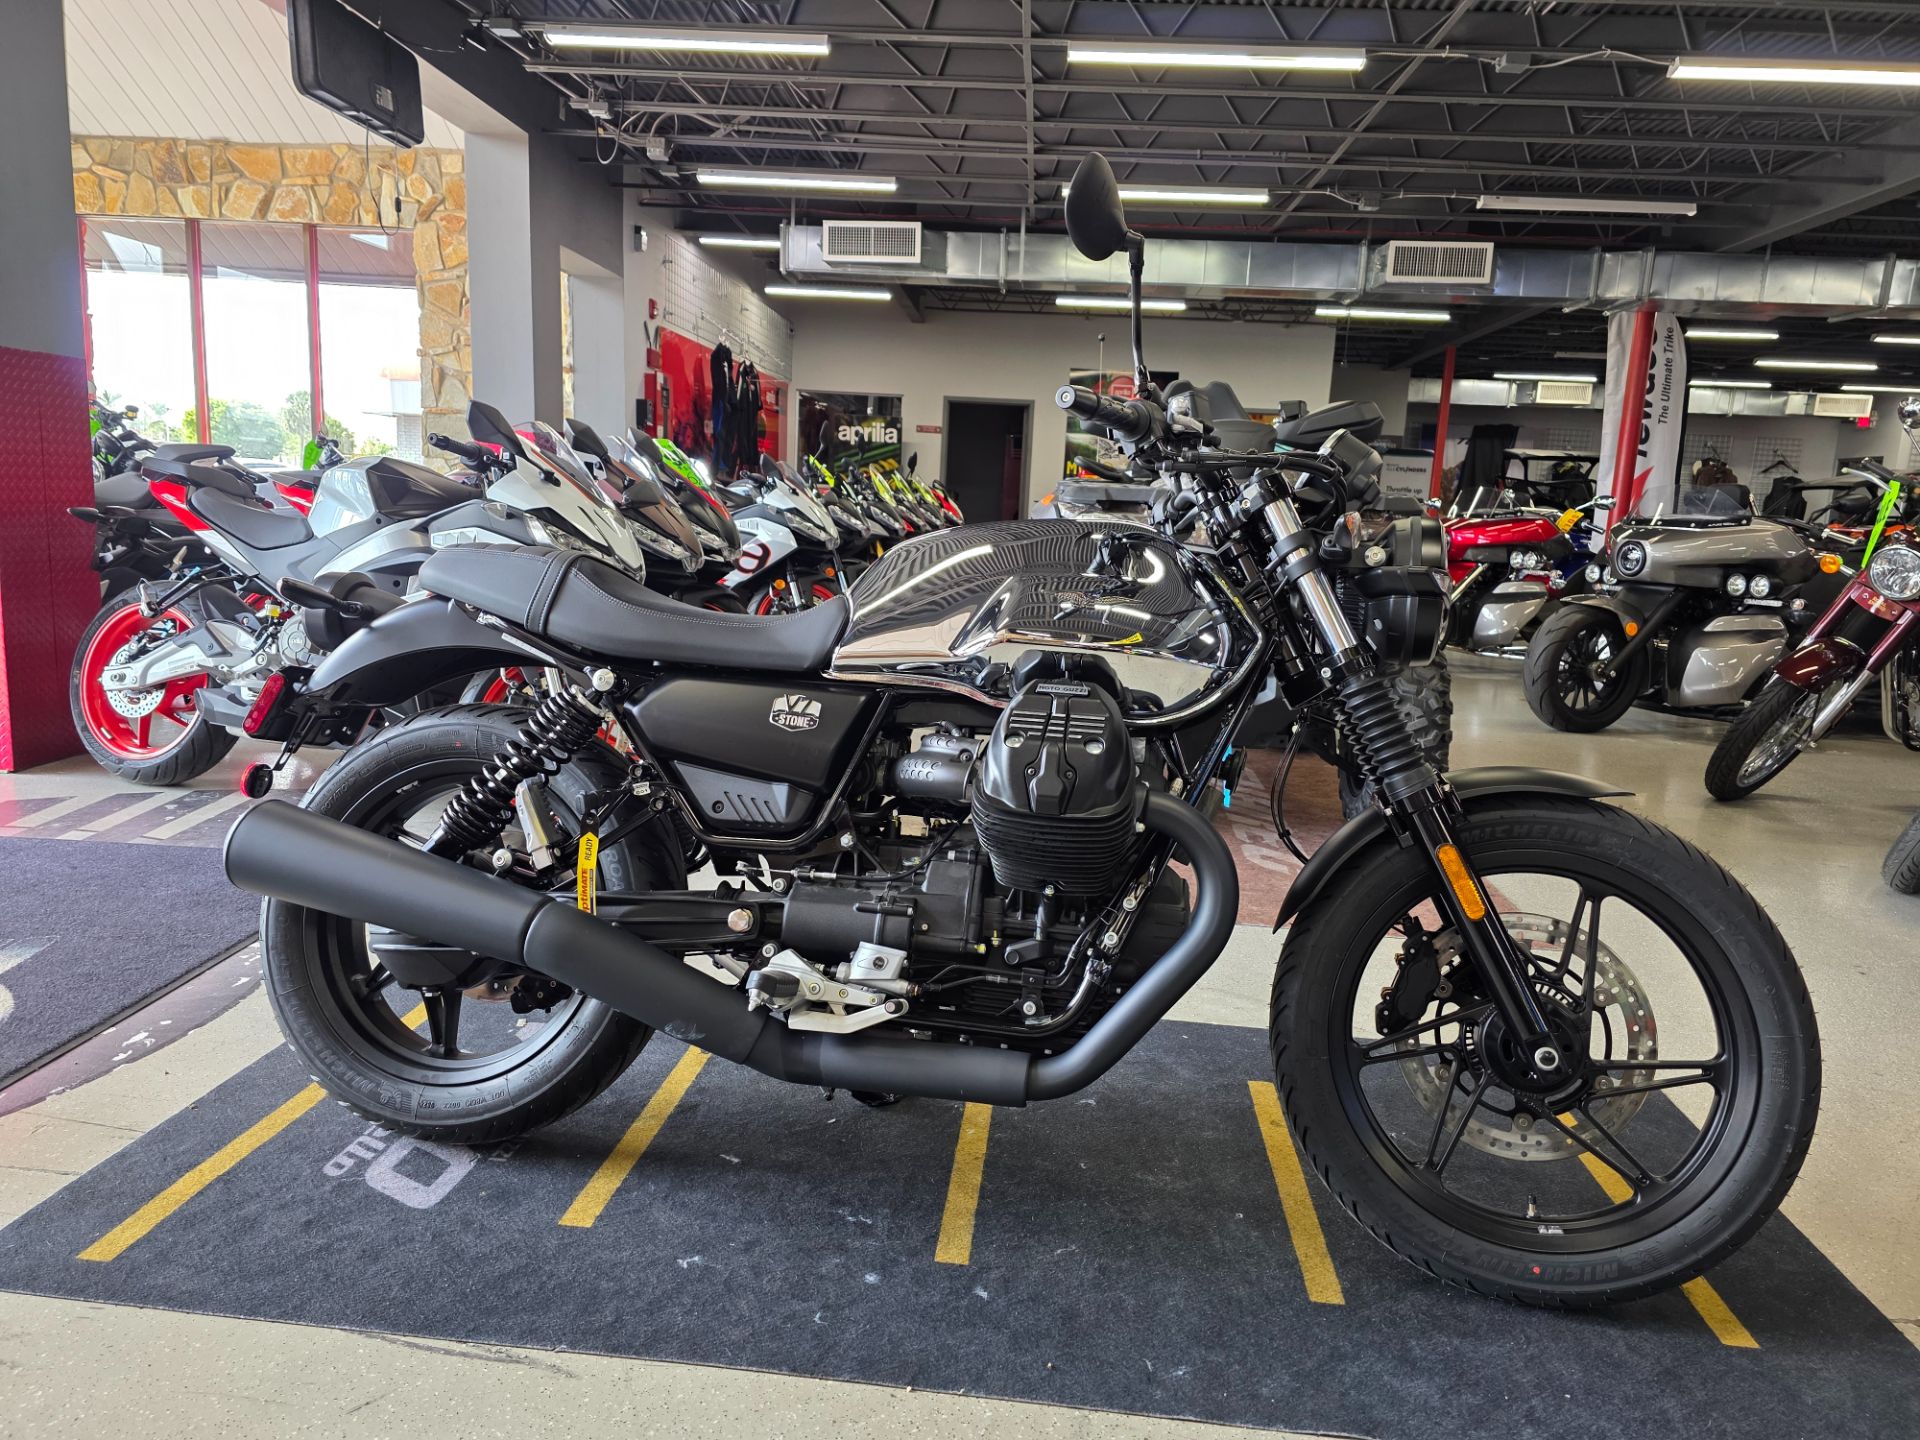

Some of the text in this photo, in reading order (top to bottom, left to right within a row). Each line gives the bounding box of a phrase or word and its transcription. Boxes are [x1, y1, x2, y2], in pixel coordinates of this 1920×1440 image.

[1658, 326, 1674, 424] The Ultimate Trike
[838, 422, 898, 446] aprilia
[784, 694, 813, 714] V7
[779, 714, 811, 727] STONE
[584, 838, 593, 860] READY
